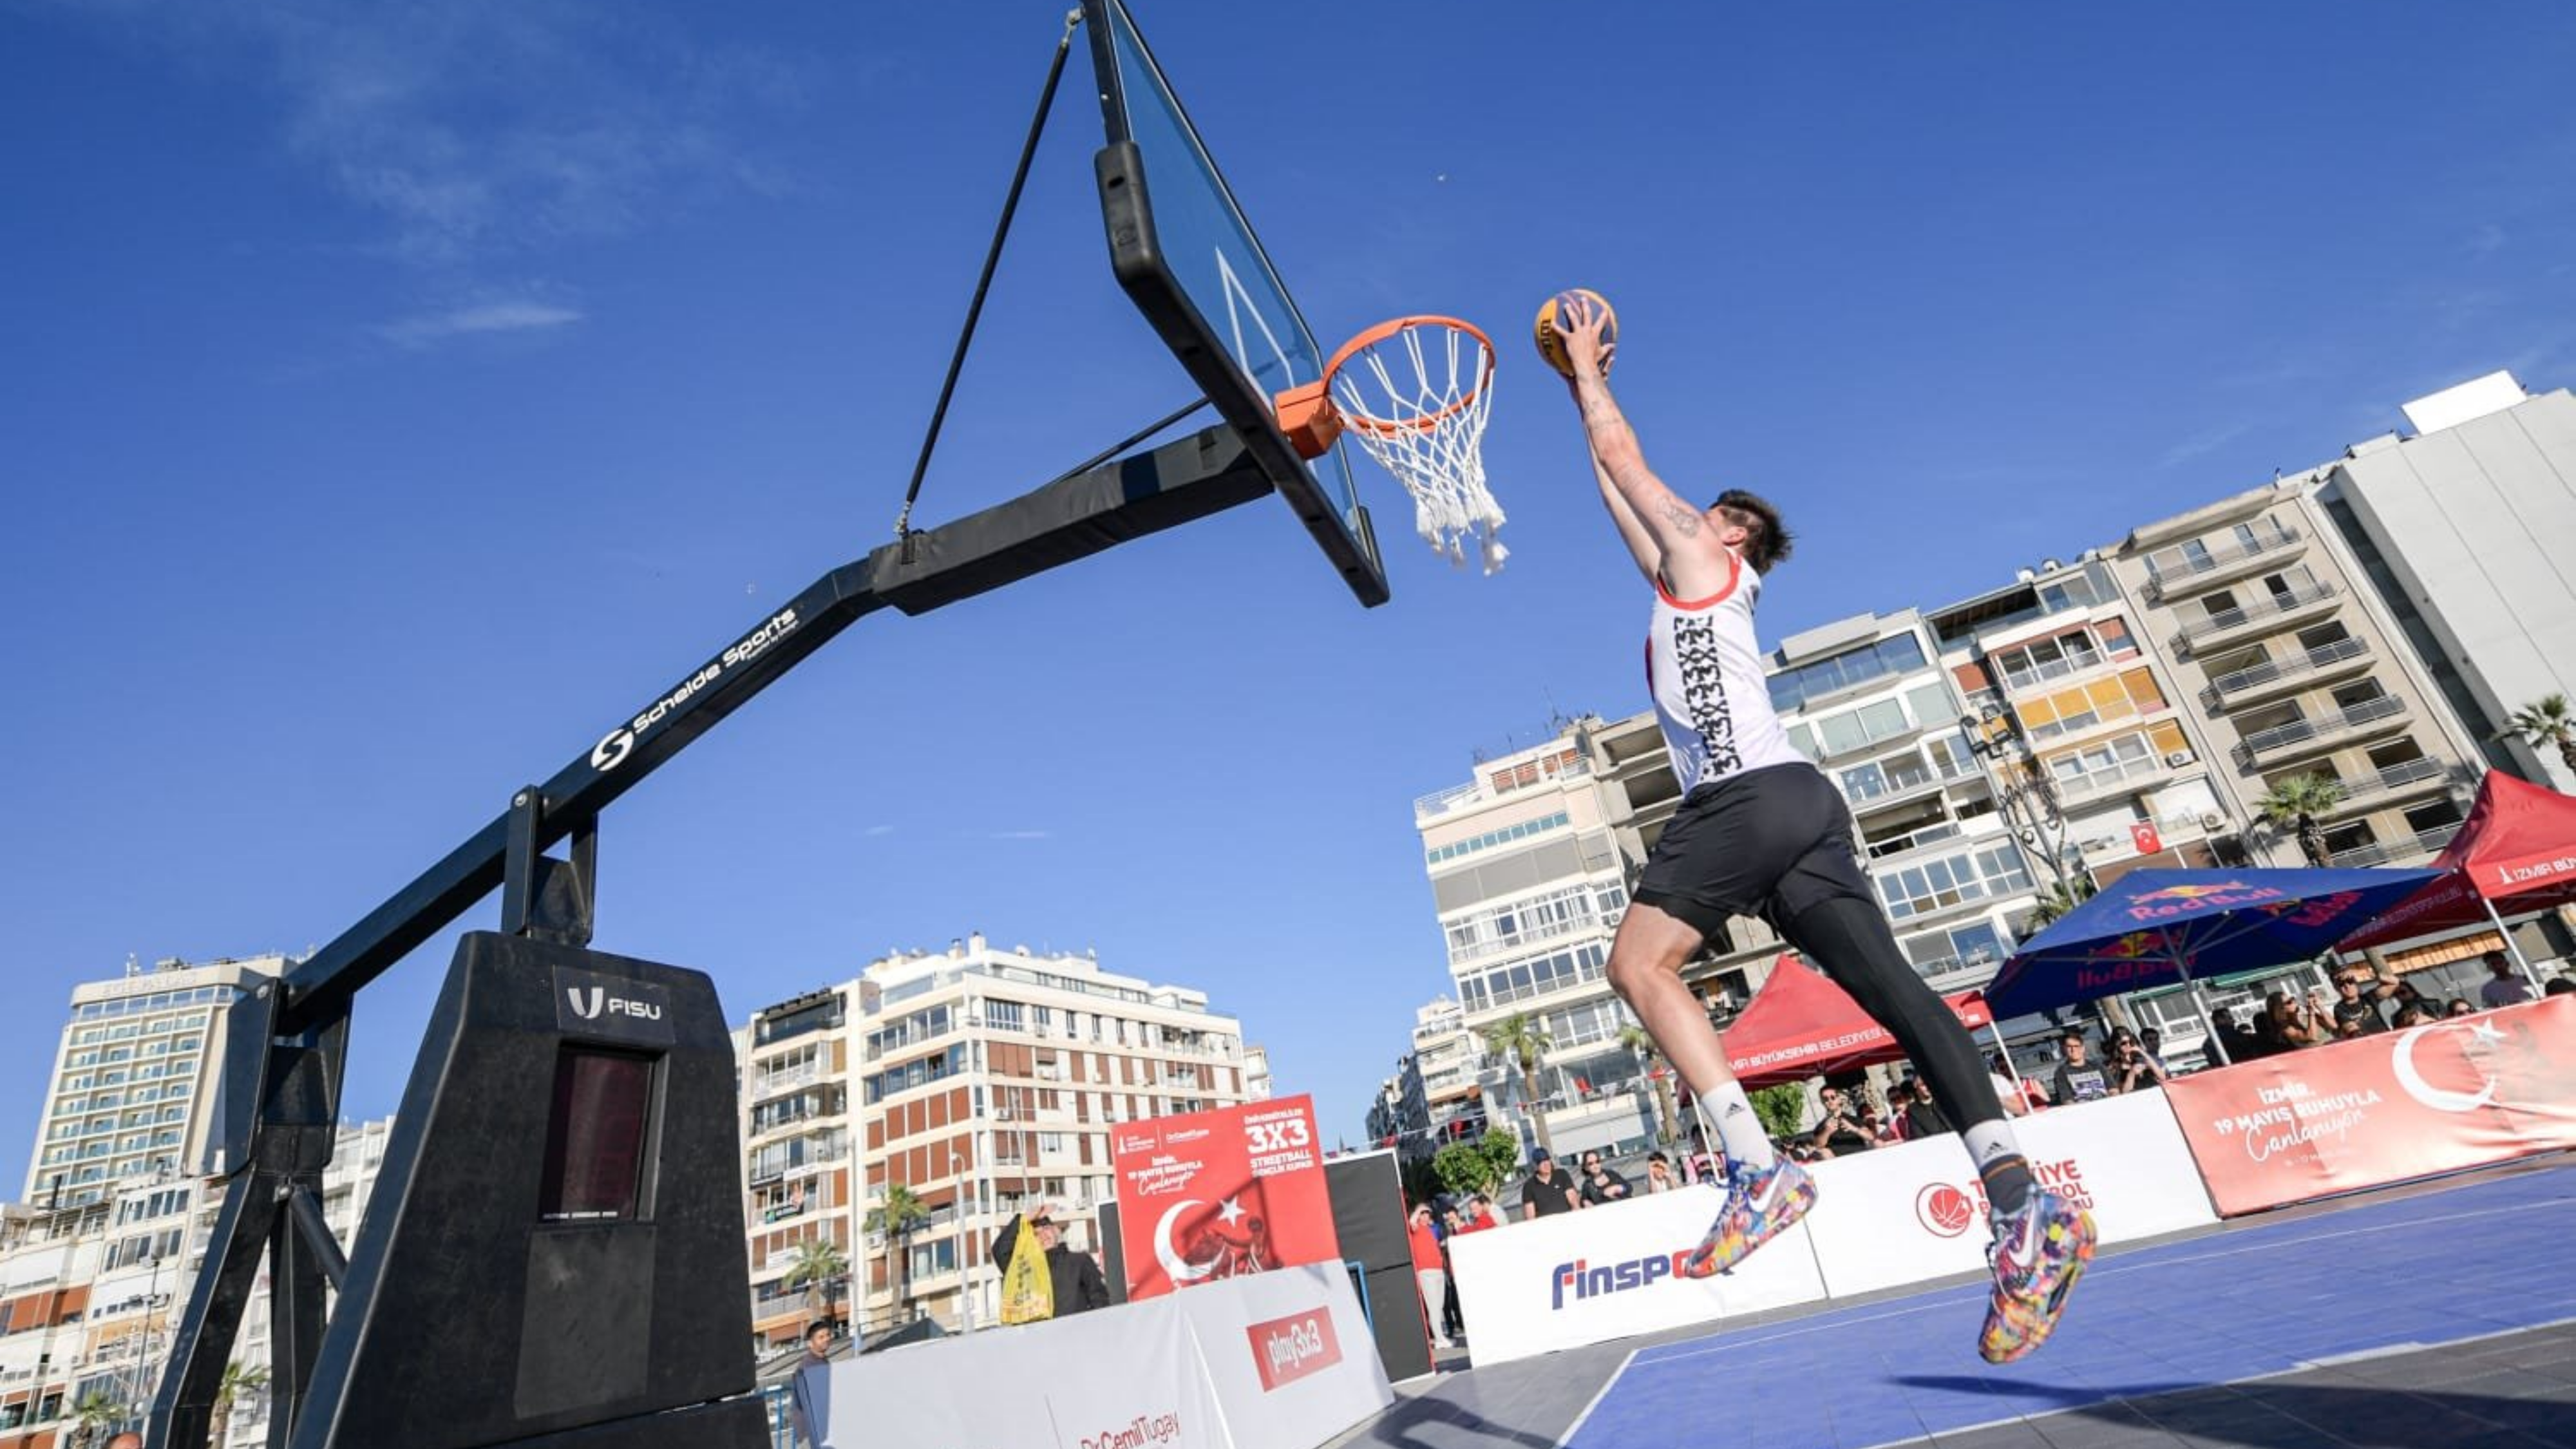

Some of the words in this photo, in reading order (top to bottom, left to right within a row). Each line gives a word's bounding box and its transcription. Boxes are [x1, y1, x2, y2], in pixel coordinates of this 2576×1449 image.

[723, 608, 796, 667] Sports
[2128, 894, 2207, 921] Red
[2209, 887, 2284, 905] Bull
[608, 998, 661, 1020] FISU
[2214, 1118, 2233, 1135] 19
[2235, 1106, 2291, 1131] MAYIS
[2293, 1089, 2382, 1117] RUHUYLA
[1244, 1119, 1309, 1154] 3X3
[1250, 1149, 1312, 1169] STREETBALL
[1267, 1318, 1323, 1374] play3x3
